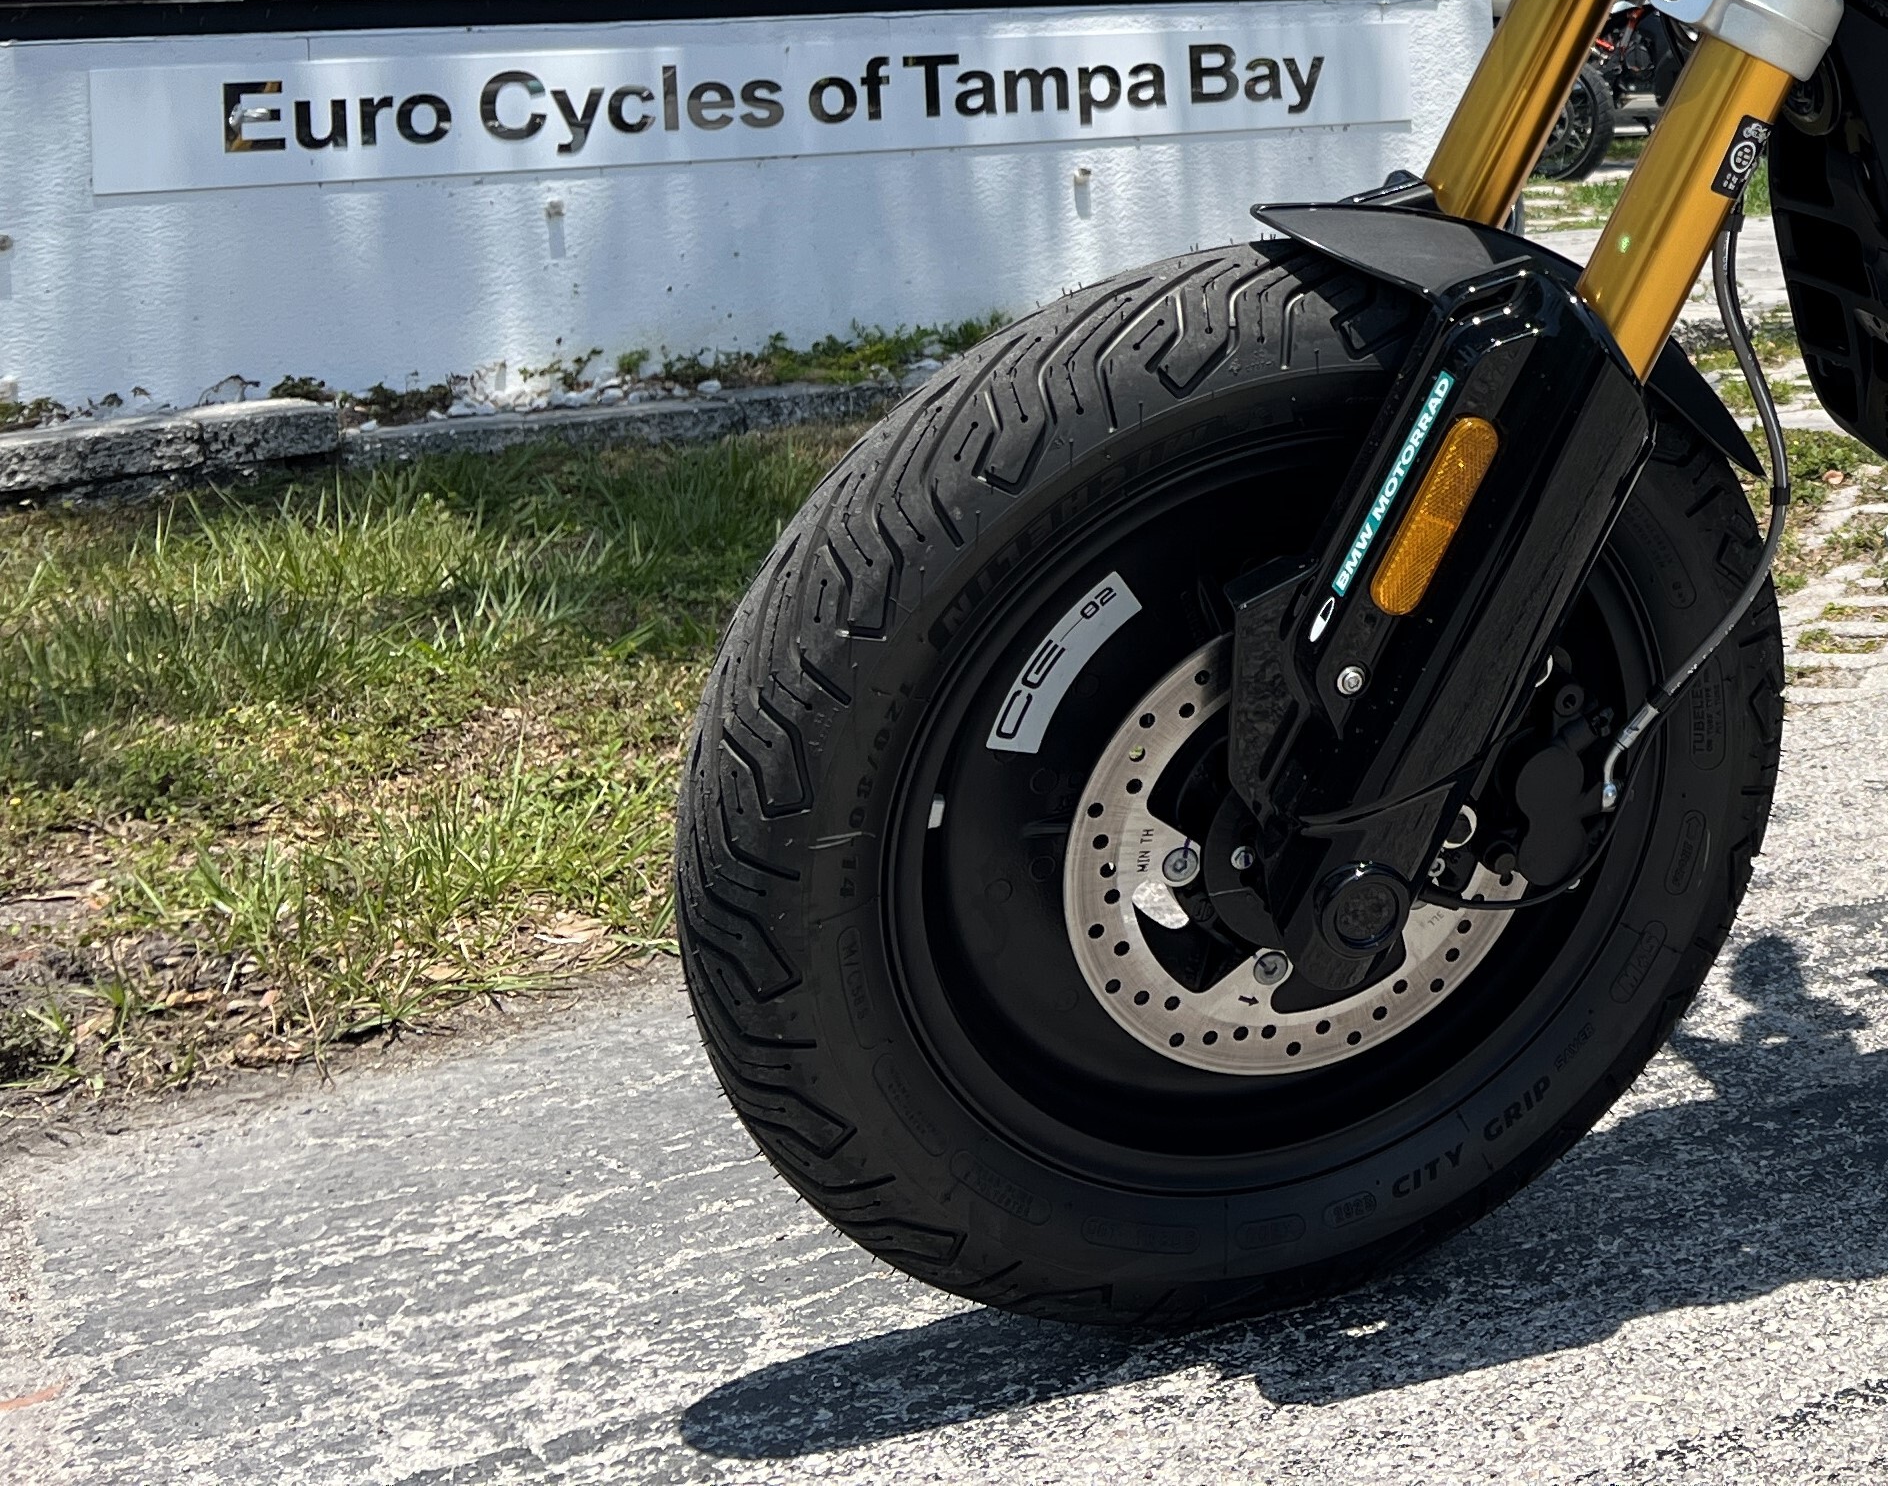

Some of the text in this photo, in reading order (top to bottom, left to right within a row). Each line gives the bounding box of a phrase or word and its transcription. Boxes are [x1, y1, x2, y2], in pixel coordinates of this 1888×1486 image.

[222, 43, 1325, 155] Euro Cycles of Tampa Bay
[1335, 377, 1450, 592] BMW MOTORRAD
[995, 586, 1117, 740] CE 02
[1136, 828, 1154, 873] MIN TH
[1391, 1021, 1596, 1199] CITY GRIP SAVER
